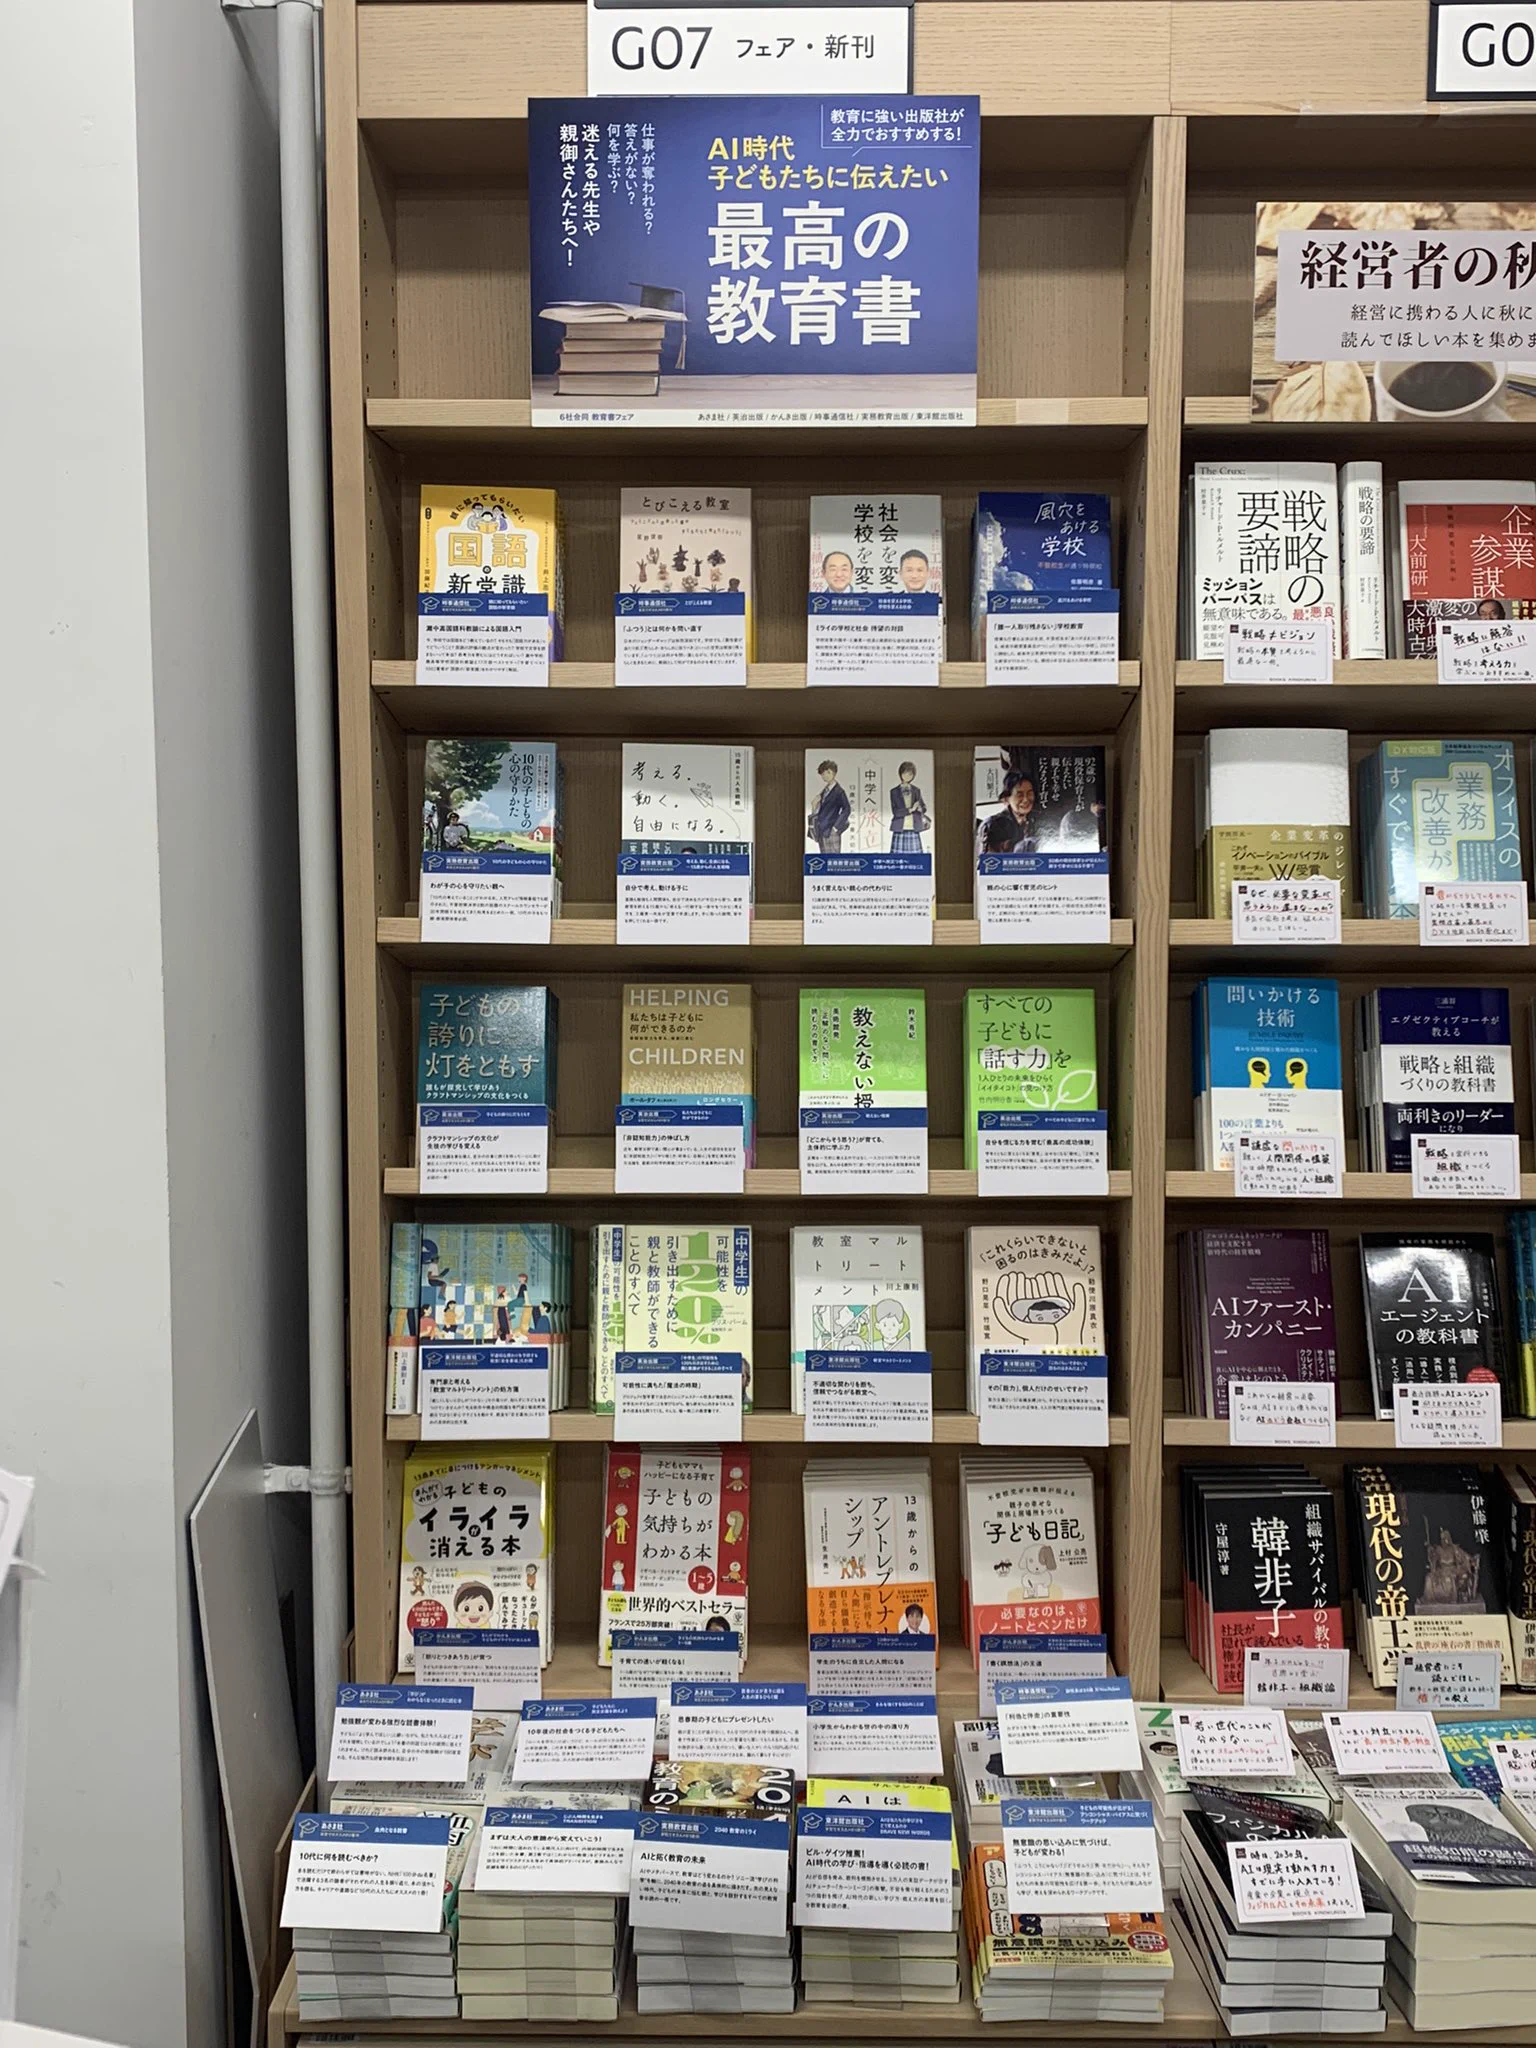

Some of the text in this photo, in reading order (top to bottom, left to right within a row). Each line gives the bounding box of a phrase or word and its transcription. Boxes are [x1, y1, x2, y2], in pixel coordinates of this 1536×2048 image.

[612, 26, 875, 70] G07 フェア・新刊
[831, 109, 965, 124] 教育に強い出版社が
[831, 127, 962, 142] 全力でおすすめする！
[607, 123, 620, 193] 何を学ぶ？
[708, 136, 795, 161] AI時代
[624, 123, 638, 205] 答えがない？
[582, 123, 601, 236] 迷える先生や
[641, 123, 655, 234] 仕事が奪われる？
[708, 164, 948, 190] 子どもたちに伝えたい
[559, 123, 579, 268] 親御さんたちへ！
[708, 200, 909, 270] 最高の
[706, 275, 921, 345] 教育書
[1351, 305, 1533, 320] 経営に携わる人に秋に
[1200, 467, 1217, 475] The
[642, 497, 730, 512] とびこえる教室
[1035, 502, 1085, 524] 風穴を
[1060, 520, 1099, 535] あける
[1359, 487, 1374, 555] 戦略の要諦
[1237, 490, 1280, 574] 要諦
[1501, 505, 1535, 570] 企業
[448, 533, 527, 568] 国語
[1042, 536, 1087, 557] 学校
[1283, 489, 1328, 607] 戦略の
[1410, 535, 1428, 595] 大前研一
[1470, 534, 1505, 599] 参謀
[1202, 578, 1263, 591] ミッション
[1202, 608, 1288, 621] 無意味である。
[509, 754, 520, 818] 心の守りかた
[521, 754, 534, 828] 10代の子どもの
[1456, 772, 1486, 831] 業務
[1493, 749, 1521, 868] オフィスの
[1421, 788, 1452, 871] 改善が
[630, 989, 729, 1006] HELPING
[977, 994, 1053, 1014] すべての
[1228, 986, 1320, 1004] 問いかける
[430, 994, 520, 1017] 子どもの
[630, 1013, 703, 1022] 私たちは子どもに
[1257, 1008, 1295, 1028] 技術
[1390, 1015, 1500, 1025] エグゼクティブコーチが
[428, 1022, 501, 1048] 誇りに
[630, 1024, 695, 1033] 何ができるのか
[977, 1022, 1052, 1042] 子どもに
[1432, 1027, 1461, 1037] 教える
[426, 1053, 539, 1079] 灯をともす
[629, 1048, 744, 1065] CHILDREN
[977, 1048, 1072, 1070] 「話す力」を
[1399, 1055, 1495, 1075] 戦略と組織
[1400, 1077, 1496, 1093] づくりの教科書
[1398, 1108, 1504, 1124] 両利きのリーダー
[980, 1234, 1088, 1263] 「これくらいできないと
[717, 1235, 729, 1293] 可能性を
[735, 1230, 749, 1297] 「中学生」の
[628, 1236, 641, 1316] ことのすべて
[666, 1236, 679, 1333] 引き出すために
[1398, 1268, 1468, 1302] AI
[647, 1236, 660, 1349] 親と教師ができる
[1211, 1297, 1332, 1317] AIファースト・
[1380, 1309, 1489, 1324] エージェント
[1224, 1320, 1322, 1340] カンパニー
[1396, 1330, 1479, 1345] の教科書
[644, 1472, 715, 1481] ハッピーになる子育て
[444, 1482, 506, 1499] 子どもの
[644, 1488, 713, 1506] 子どもの
[419, 1505, 530, 1532] イライラ
[642, 1516, 713, 1534] 気持ちが
[845, 1498, 864, 1548] シップ
[904, 1496, 918, 1571] 13歳からの
[983, 1519, 1085, 1544] 「子ども日記」
[430, 1535, 521, 1558] 消える本
[642, 1544, 713, 1561] わかる本
[1250, 1517, 1296, 1638] 韓非子
[628, 1597, 746, 1614] 世界的ベストセラー
[1001, 1606, 1075, 1620] 必要なのは、
[988, 1617, 1087, 1634] ノートとペンだけ
[1221, 1624, 1255, 1637] 社長が
[806, 1848, 865, 1857] ビル・ゲイツ推薦！
[1013, 1838, 1112, 1847] 無意識の思い込みに気づけば、
[1013, 1848, 1065, 1857] 子どもが変わる！
[299, 1852, 378, 1863] 10代に何を読むべきか？
[640, 1852, 706, 1864] AIと拓く教育の未来
[806, 1859, 929, 1871] AI時代の学び・指導を導く必読の書！
[992, 1938, 1126, 1948] 無意識の思い込み
